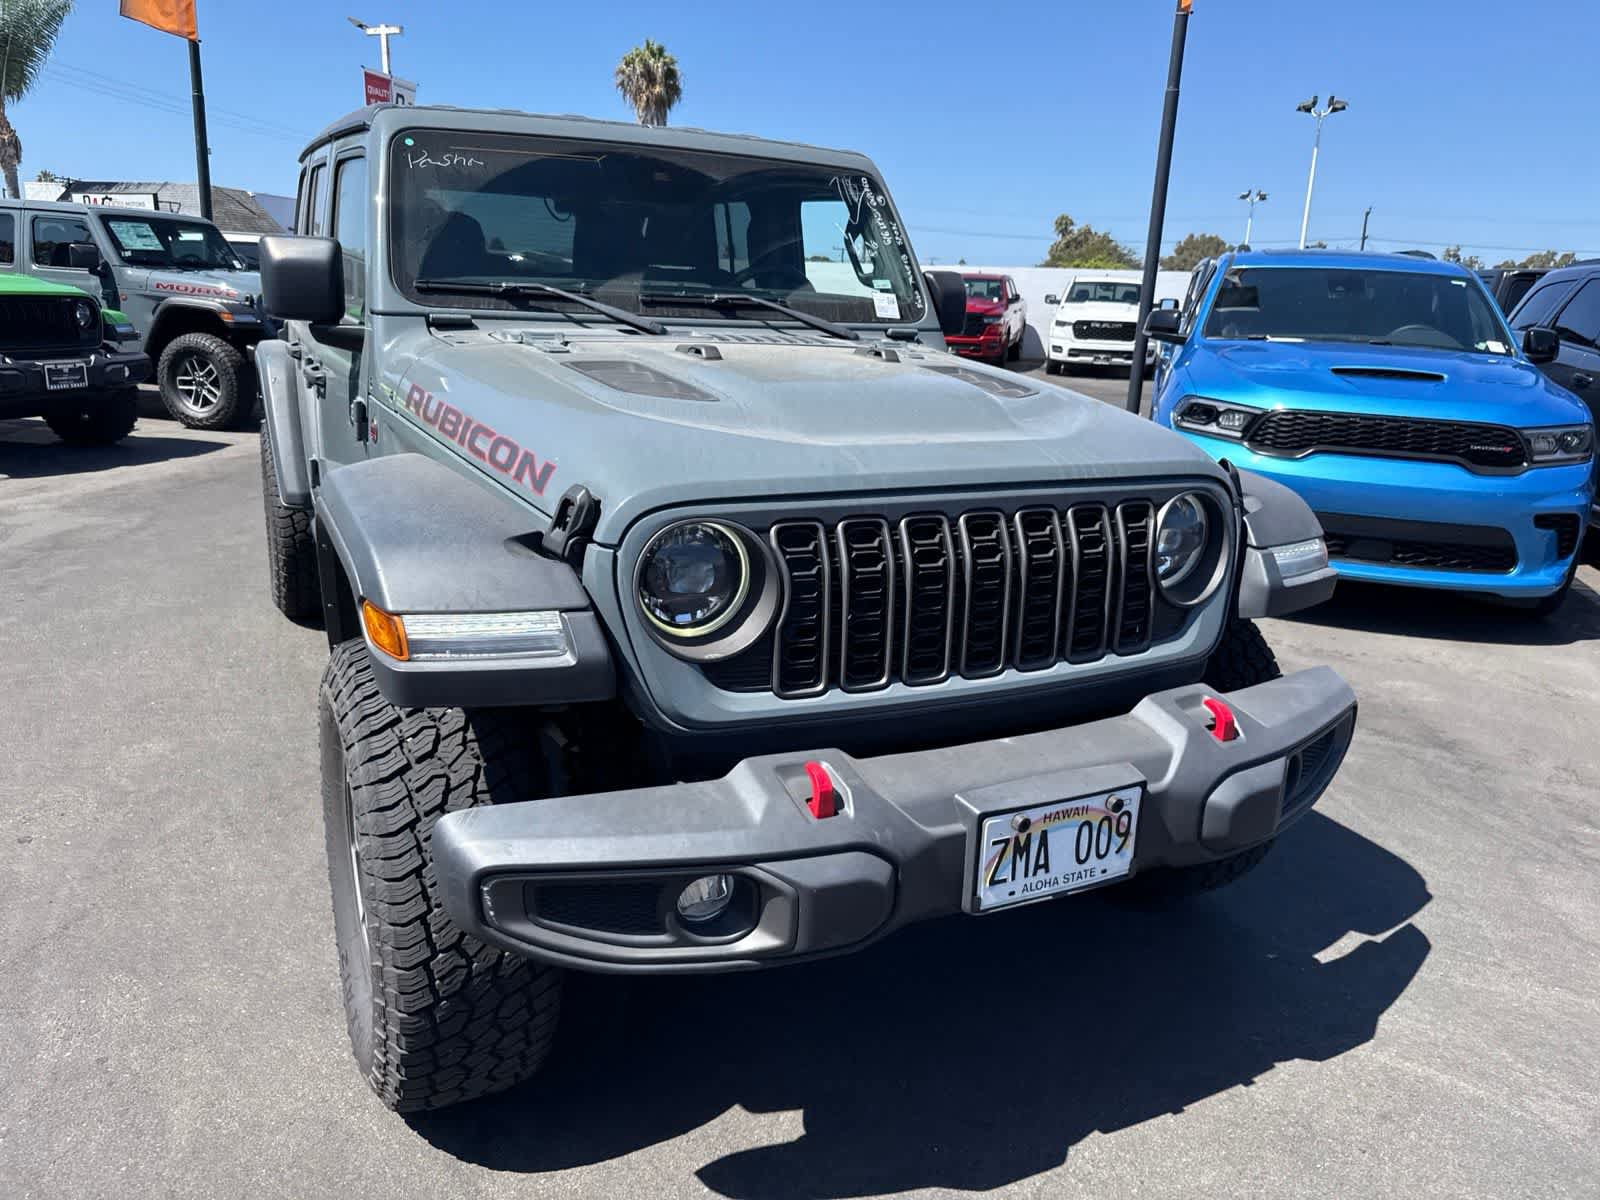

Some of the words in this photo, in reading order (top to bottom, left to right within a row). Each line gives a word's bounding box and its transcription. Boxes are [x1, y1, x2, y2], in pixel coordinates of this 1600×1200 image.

[155, 282, 239, 298] MOJAVE
[406, 383, 557, 496] RUBICON
[1043, 805, 1089, 824] HAWAII
[988, 829, 1050, 887] ZMA
[1075, 810, 1132, 865] 009
[1022, 877, 1060, 894] ALOHA
[1063, 867, 1096, 884] STATE
